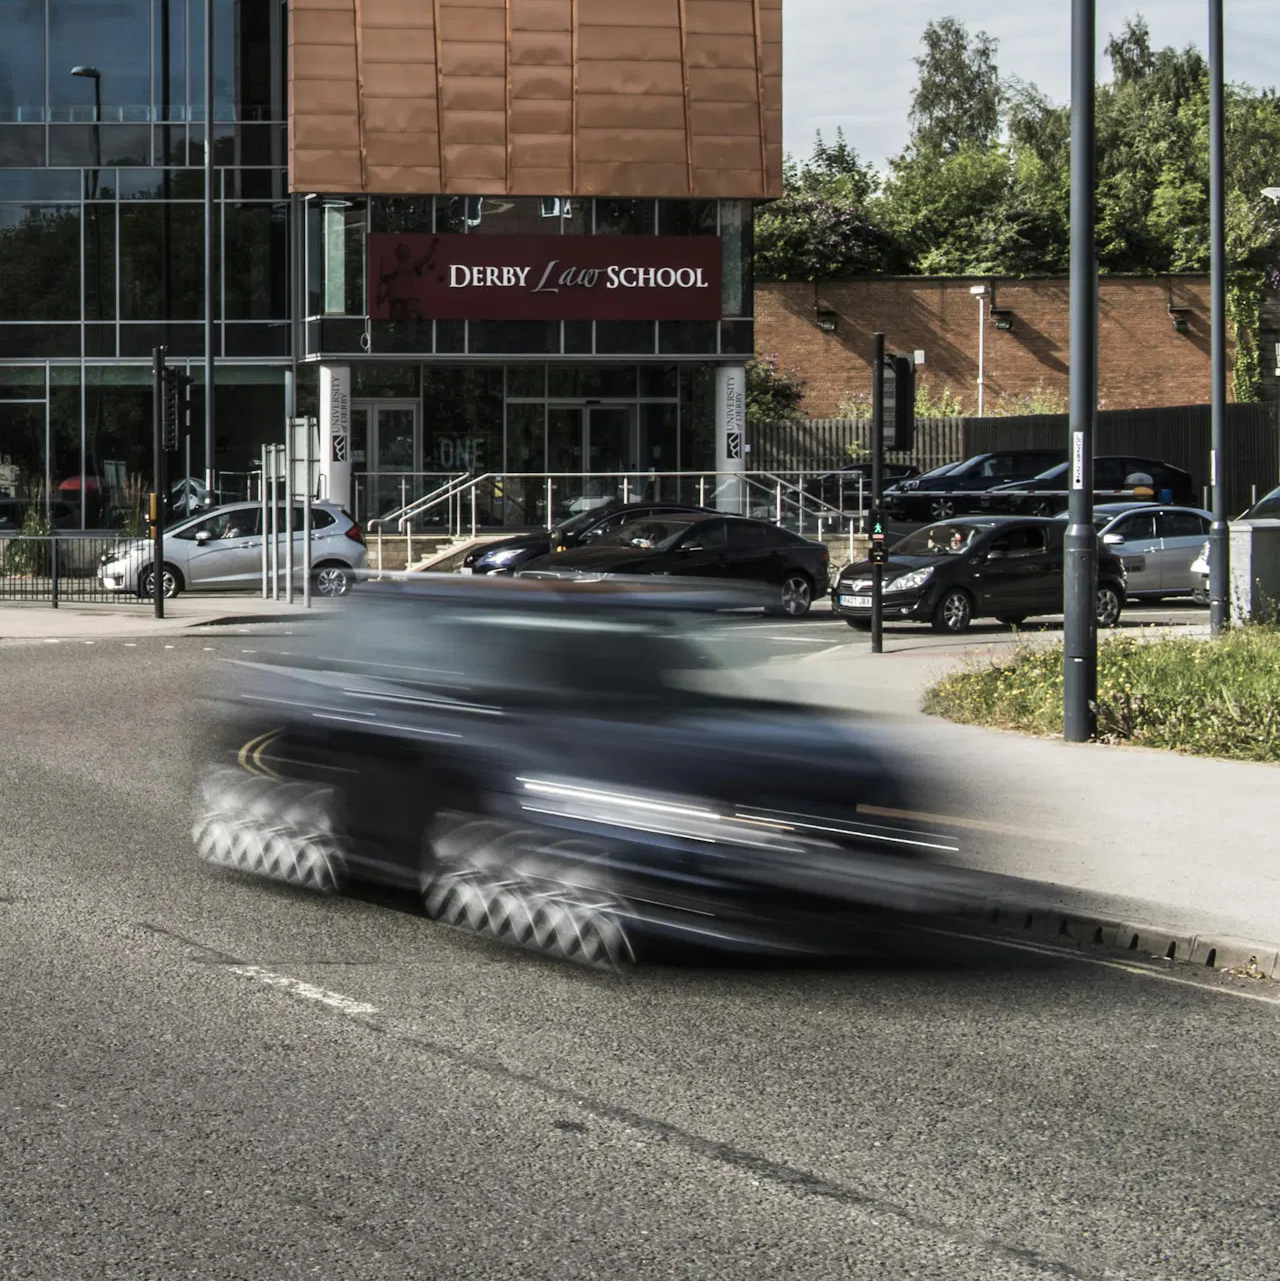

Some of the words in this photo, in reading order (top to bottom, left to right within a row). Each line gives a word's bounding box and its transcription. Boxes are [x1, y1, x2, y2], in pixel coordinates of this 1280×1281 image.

[448, 264, 531, 287] DERBY
[531, 259, 608, 293] Law
[605, 265, 709, 289] SCHOOL
[331, 376, 340, 434] UNIVERSITY
[726, 375, 735, 431] UNIVERSITY
[735, 391, 743, 422] DERBY
